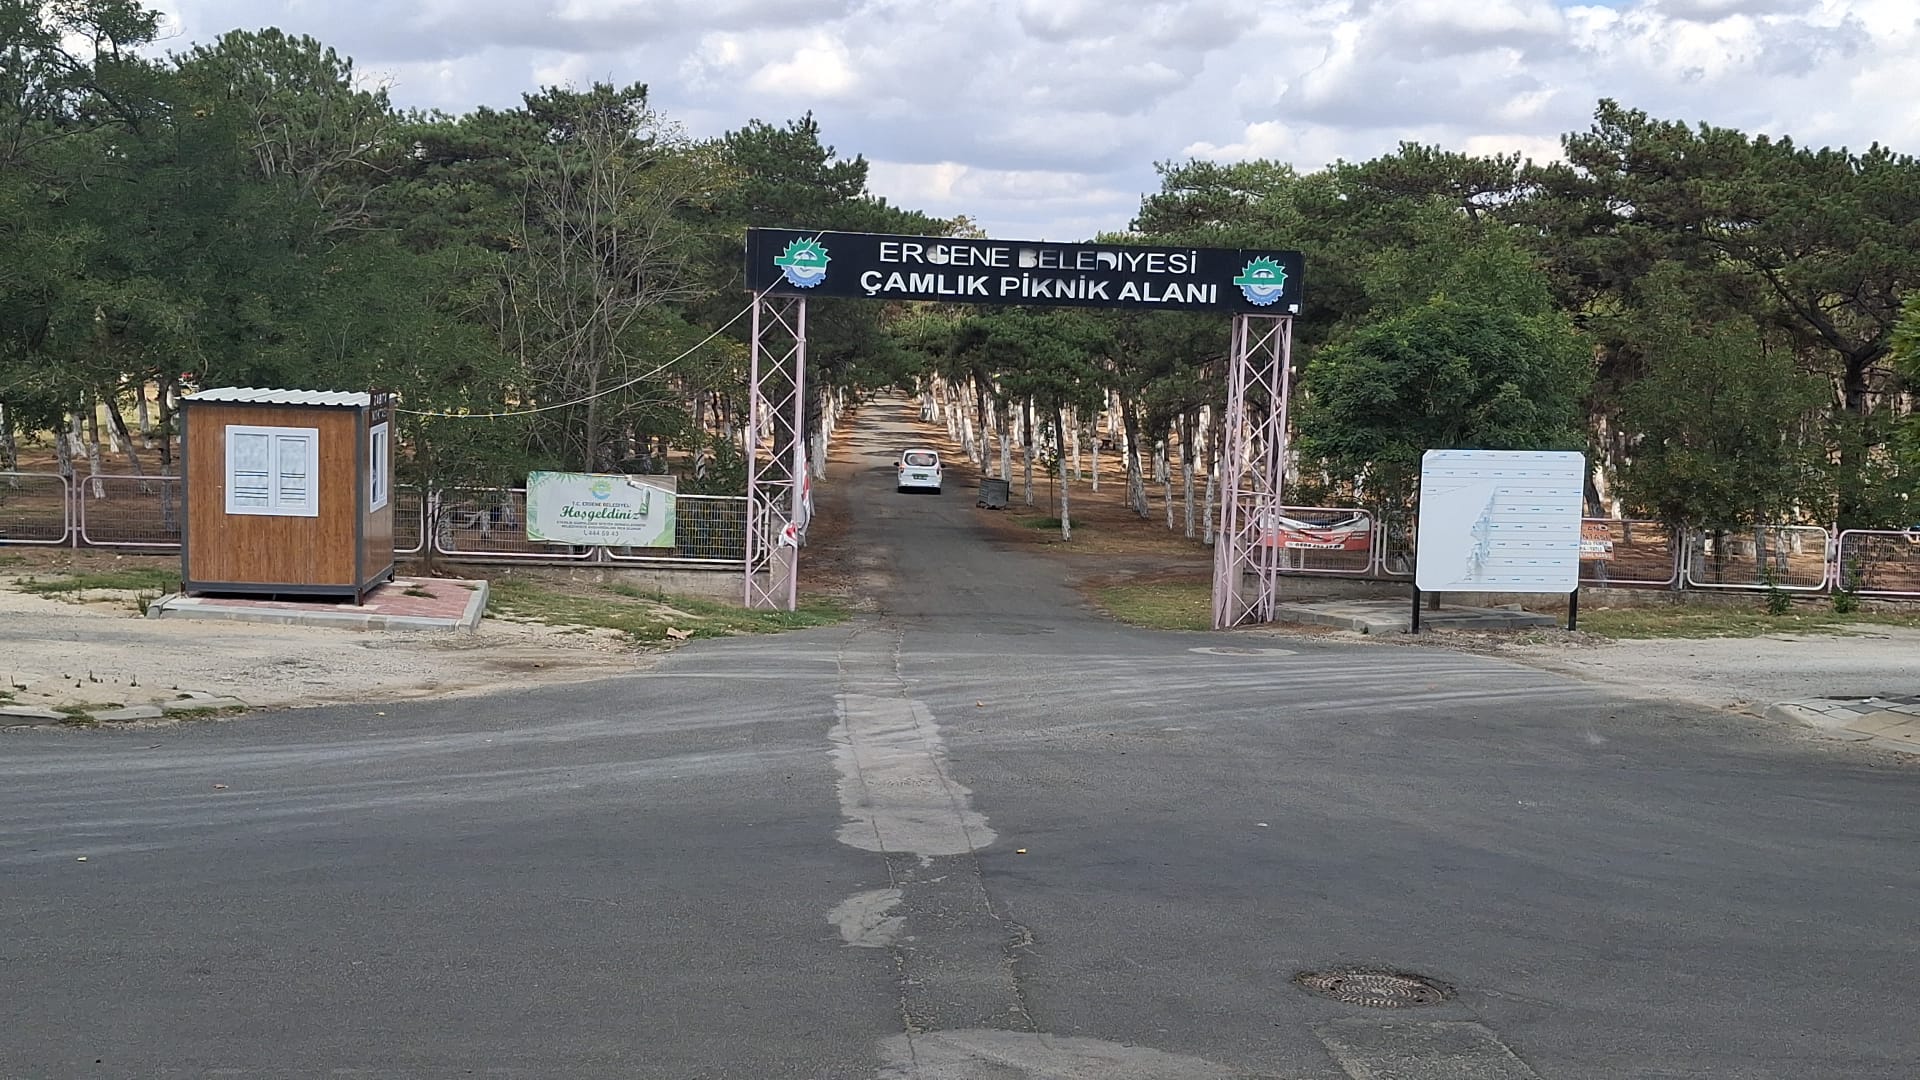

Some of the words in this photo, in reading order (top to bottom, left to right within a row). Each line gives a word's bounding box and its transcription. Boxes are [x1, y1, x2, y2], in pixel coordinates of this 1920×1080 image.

[879, 241, 1011, 268] ERGENE
[860, 270, 990, 296] ÇAMLIK
[999, 272, 1110, 301] PİKNİK
[1117, 280, 1218, 304] ALANI
[559, 505, 640, 521] Hoşgeldiniz
